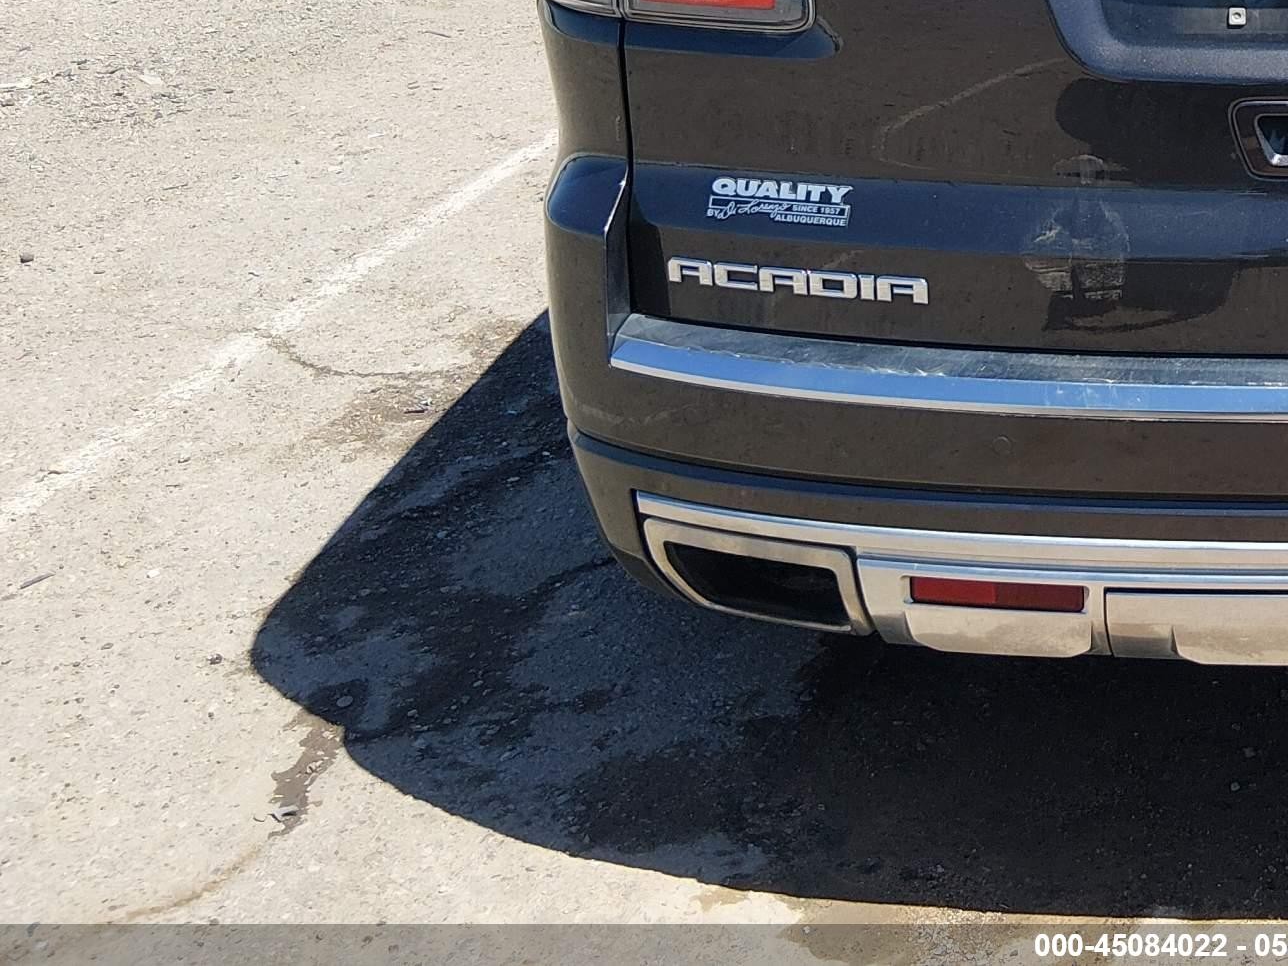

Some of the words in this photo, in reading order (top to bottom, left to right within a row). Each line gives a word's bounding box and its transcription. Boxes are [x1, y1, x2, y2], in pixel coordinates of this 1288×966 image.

[712, 177, 853, 204] QUALITY
[706, 208, 719, 217] BY
[792, 204, 818, 213] SINCE
[820, 205, 840, 215] 1957
[774, 214, 848, 226] ALBUQUERQUE
[667, 256, 929, 304] ACADIA
